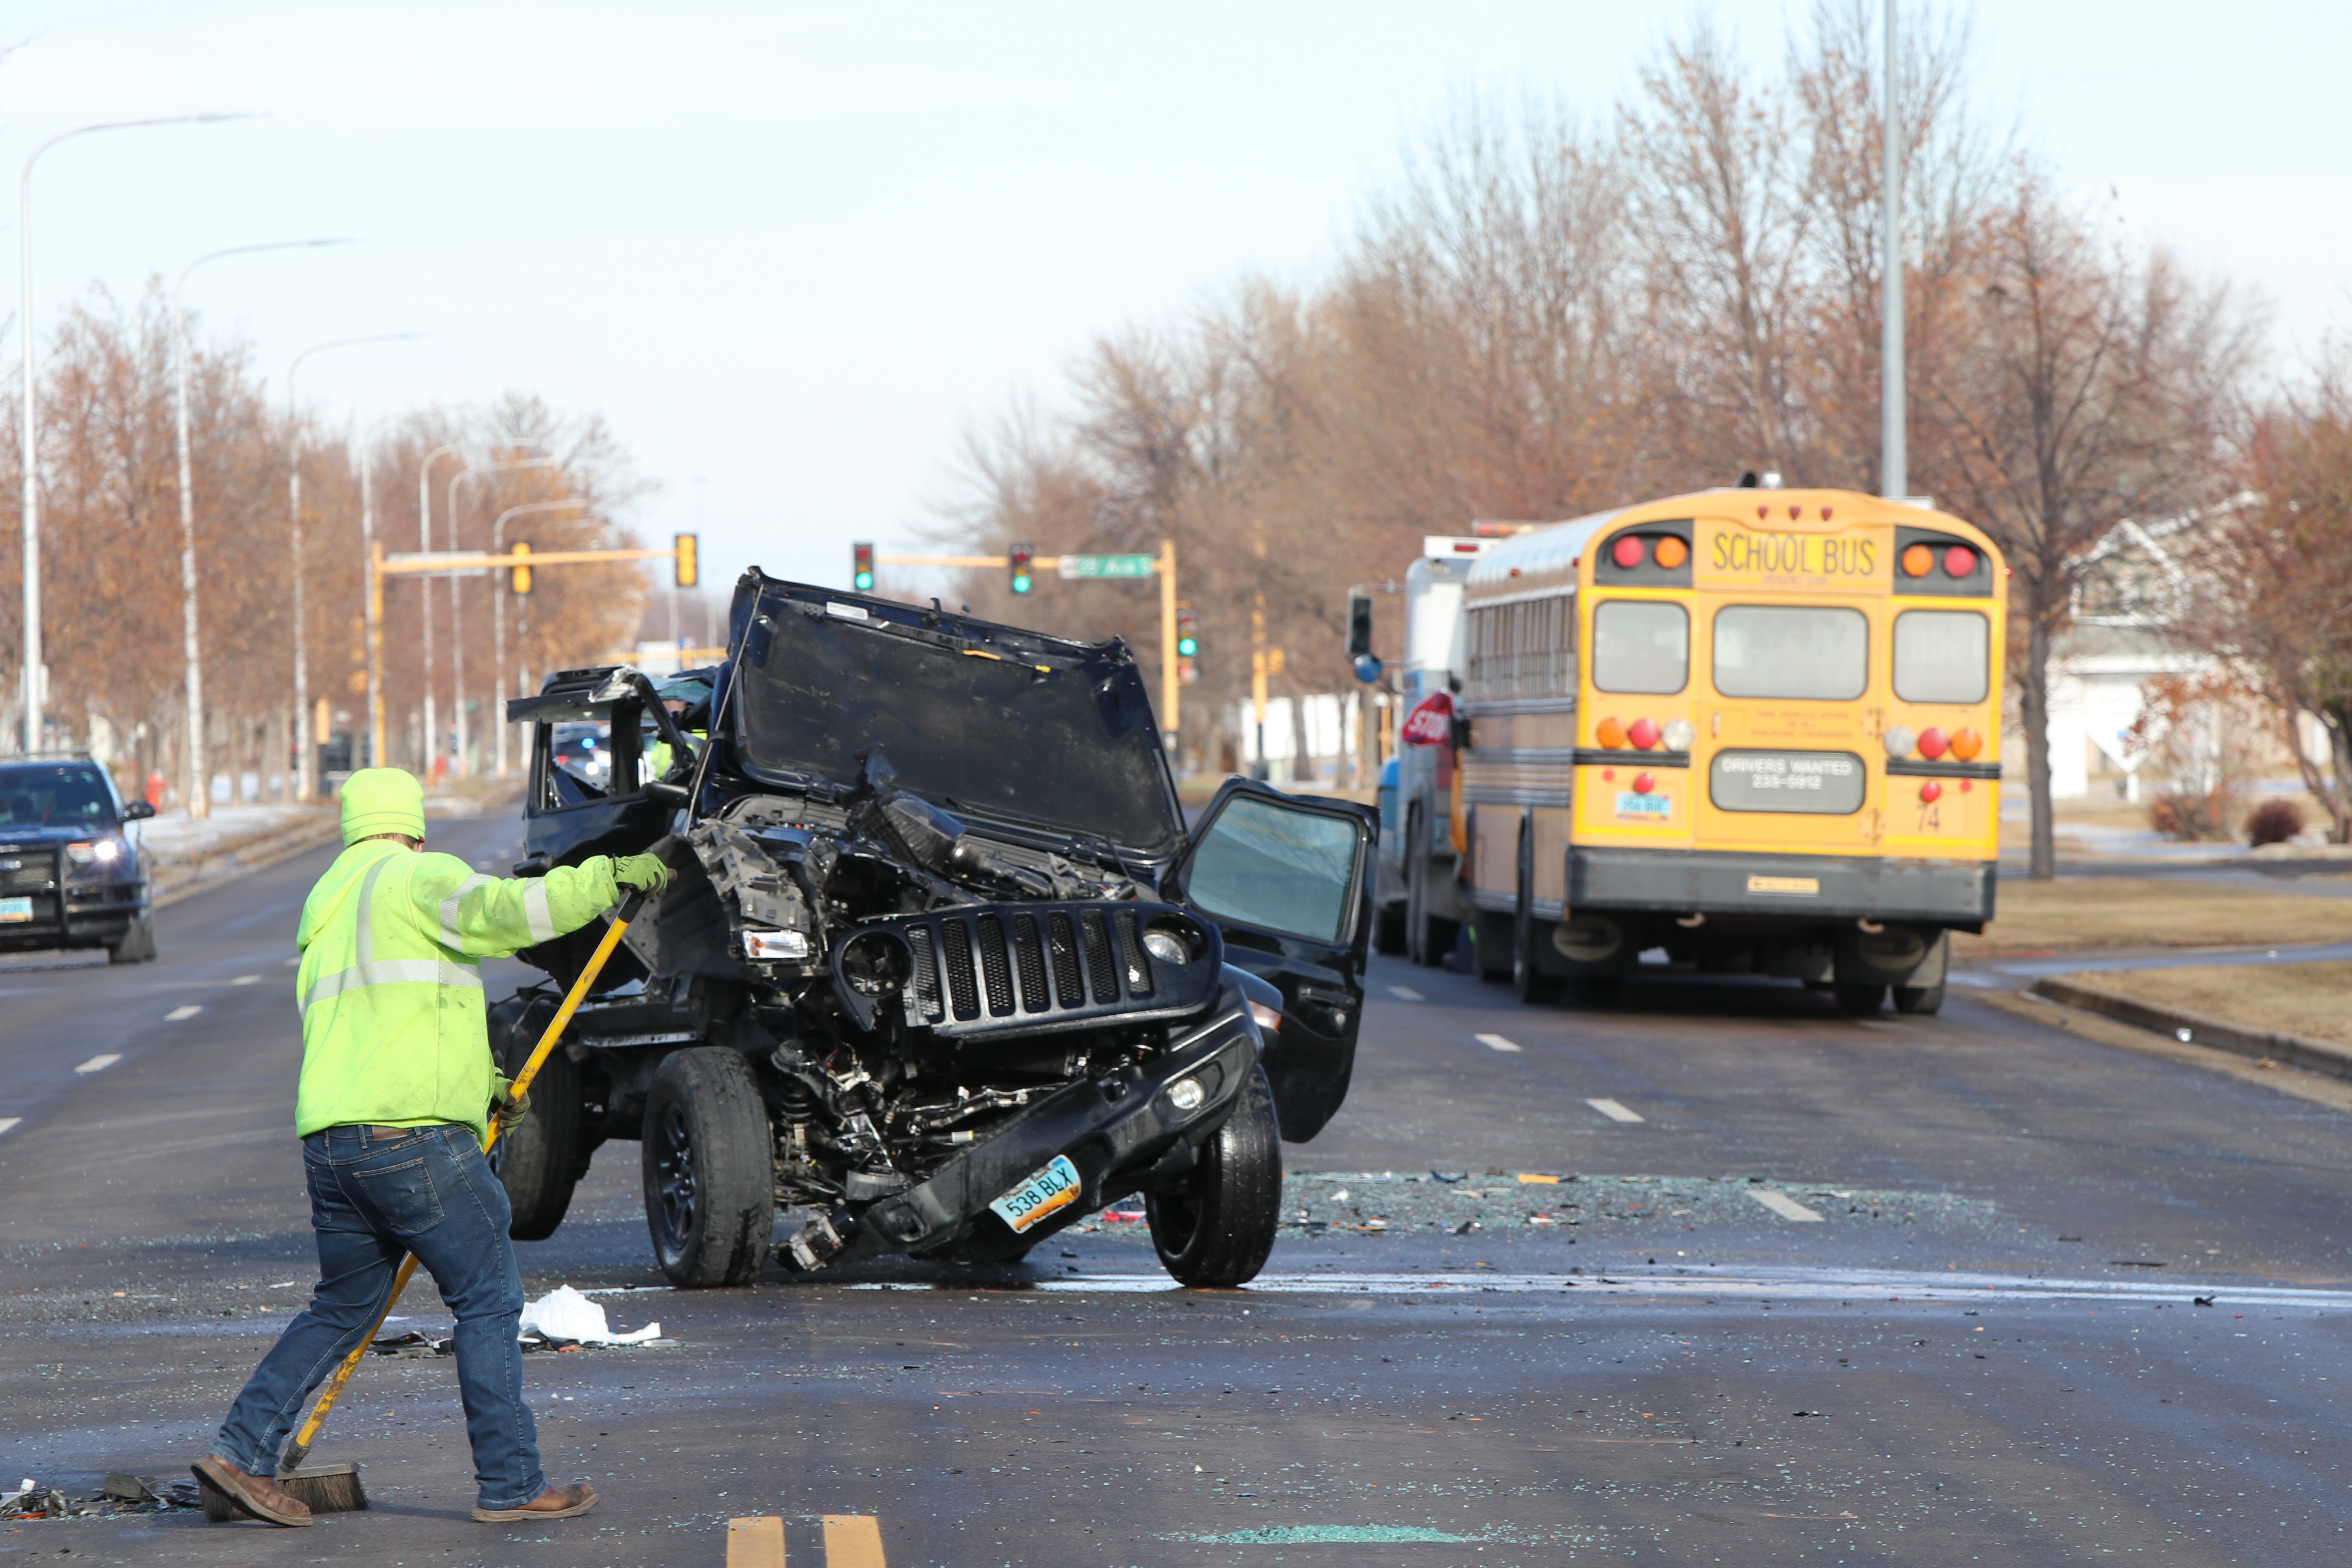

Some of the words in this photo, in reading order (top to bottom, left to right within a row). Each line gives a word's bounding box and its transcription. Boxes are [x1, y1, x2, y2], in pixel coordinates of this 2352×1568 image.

[1713, 533, 1812, 572] SCHOOL
[1824, 539, 1874, 576] BUS
[1721, 757, 1786, 775] DRIVERS
[1790, 759, 1853, 776] WANTED
[1916, 803, 1940, 831] 74
[616, 855, 639, 873] FLX
[1006, 1190, 1042, 1217] 538
[1038, 1167, 1073, 1197] BLX
